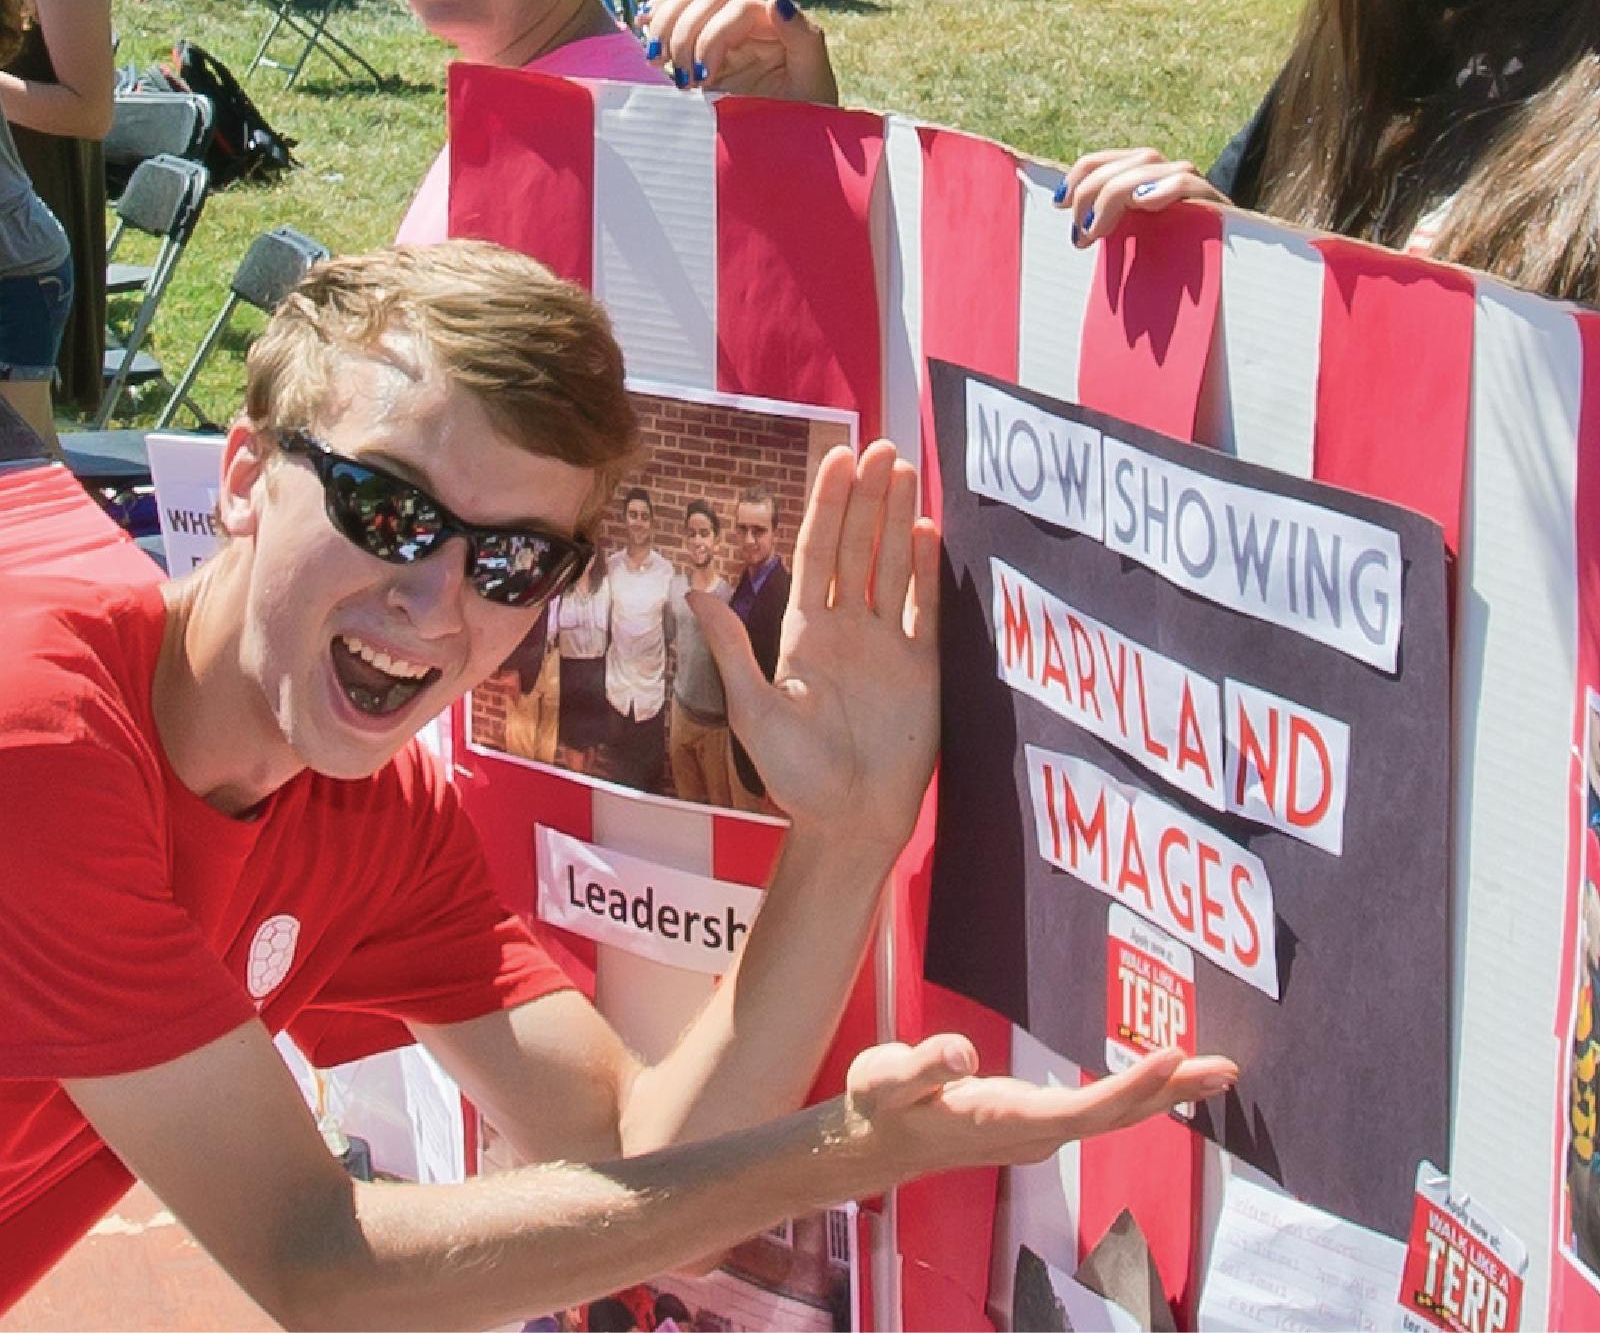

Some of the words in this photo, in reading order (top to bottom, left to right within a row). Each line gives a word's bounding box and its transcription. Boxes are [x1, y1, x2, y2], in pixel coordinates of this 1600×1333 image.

[977, 402, 1091, 521] NOW
[1113, 457, 1391, 647] SHOWING
[1000, 572, 1334, 828] MARYLAND
[1041, 763, 1262, 969] IMAGES
[1118, 965, 1188, 1052] TERP
[1424, 1227, 1509, 1333] TERP
[1428, 1209, 1468, 1258] WALK
[1469, 1243, 1499, 1279] LIKE
[1499, 1272, 1509, 1295] A
